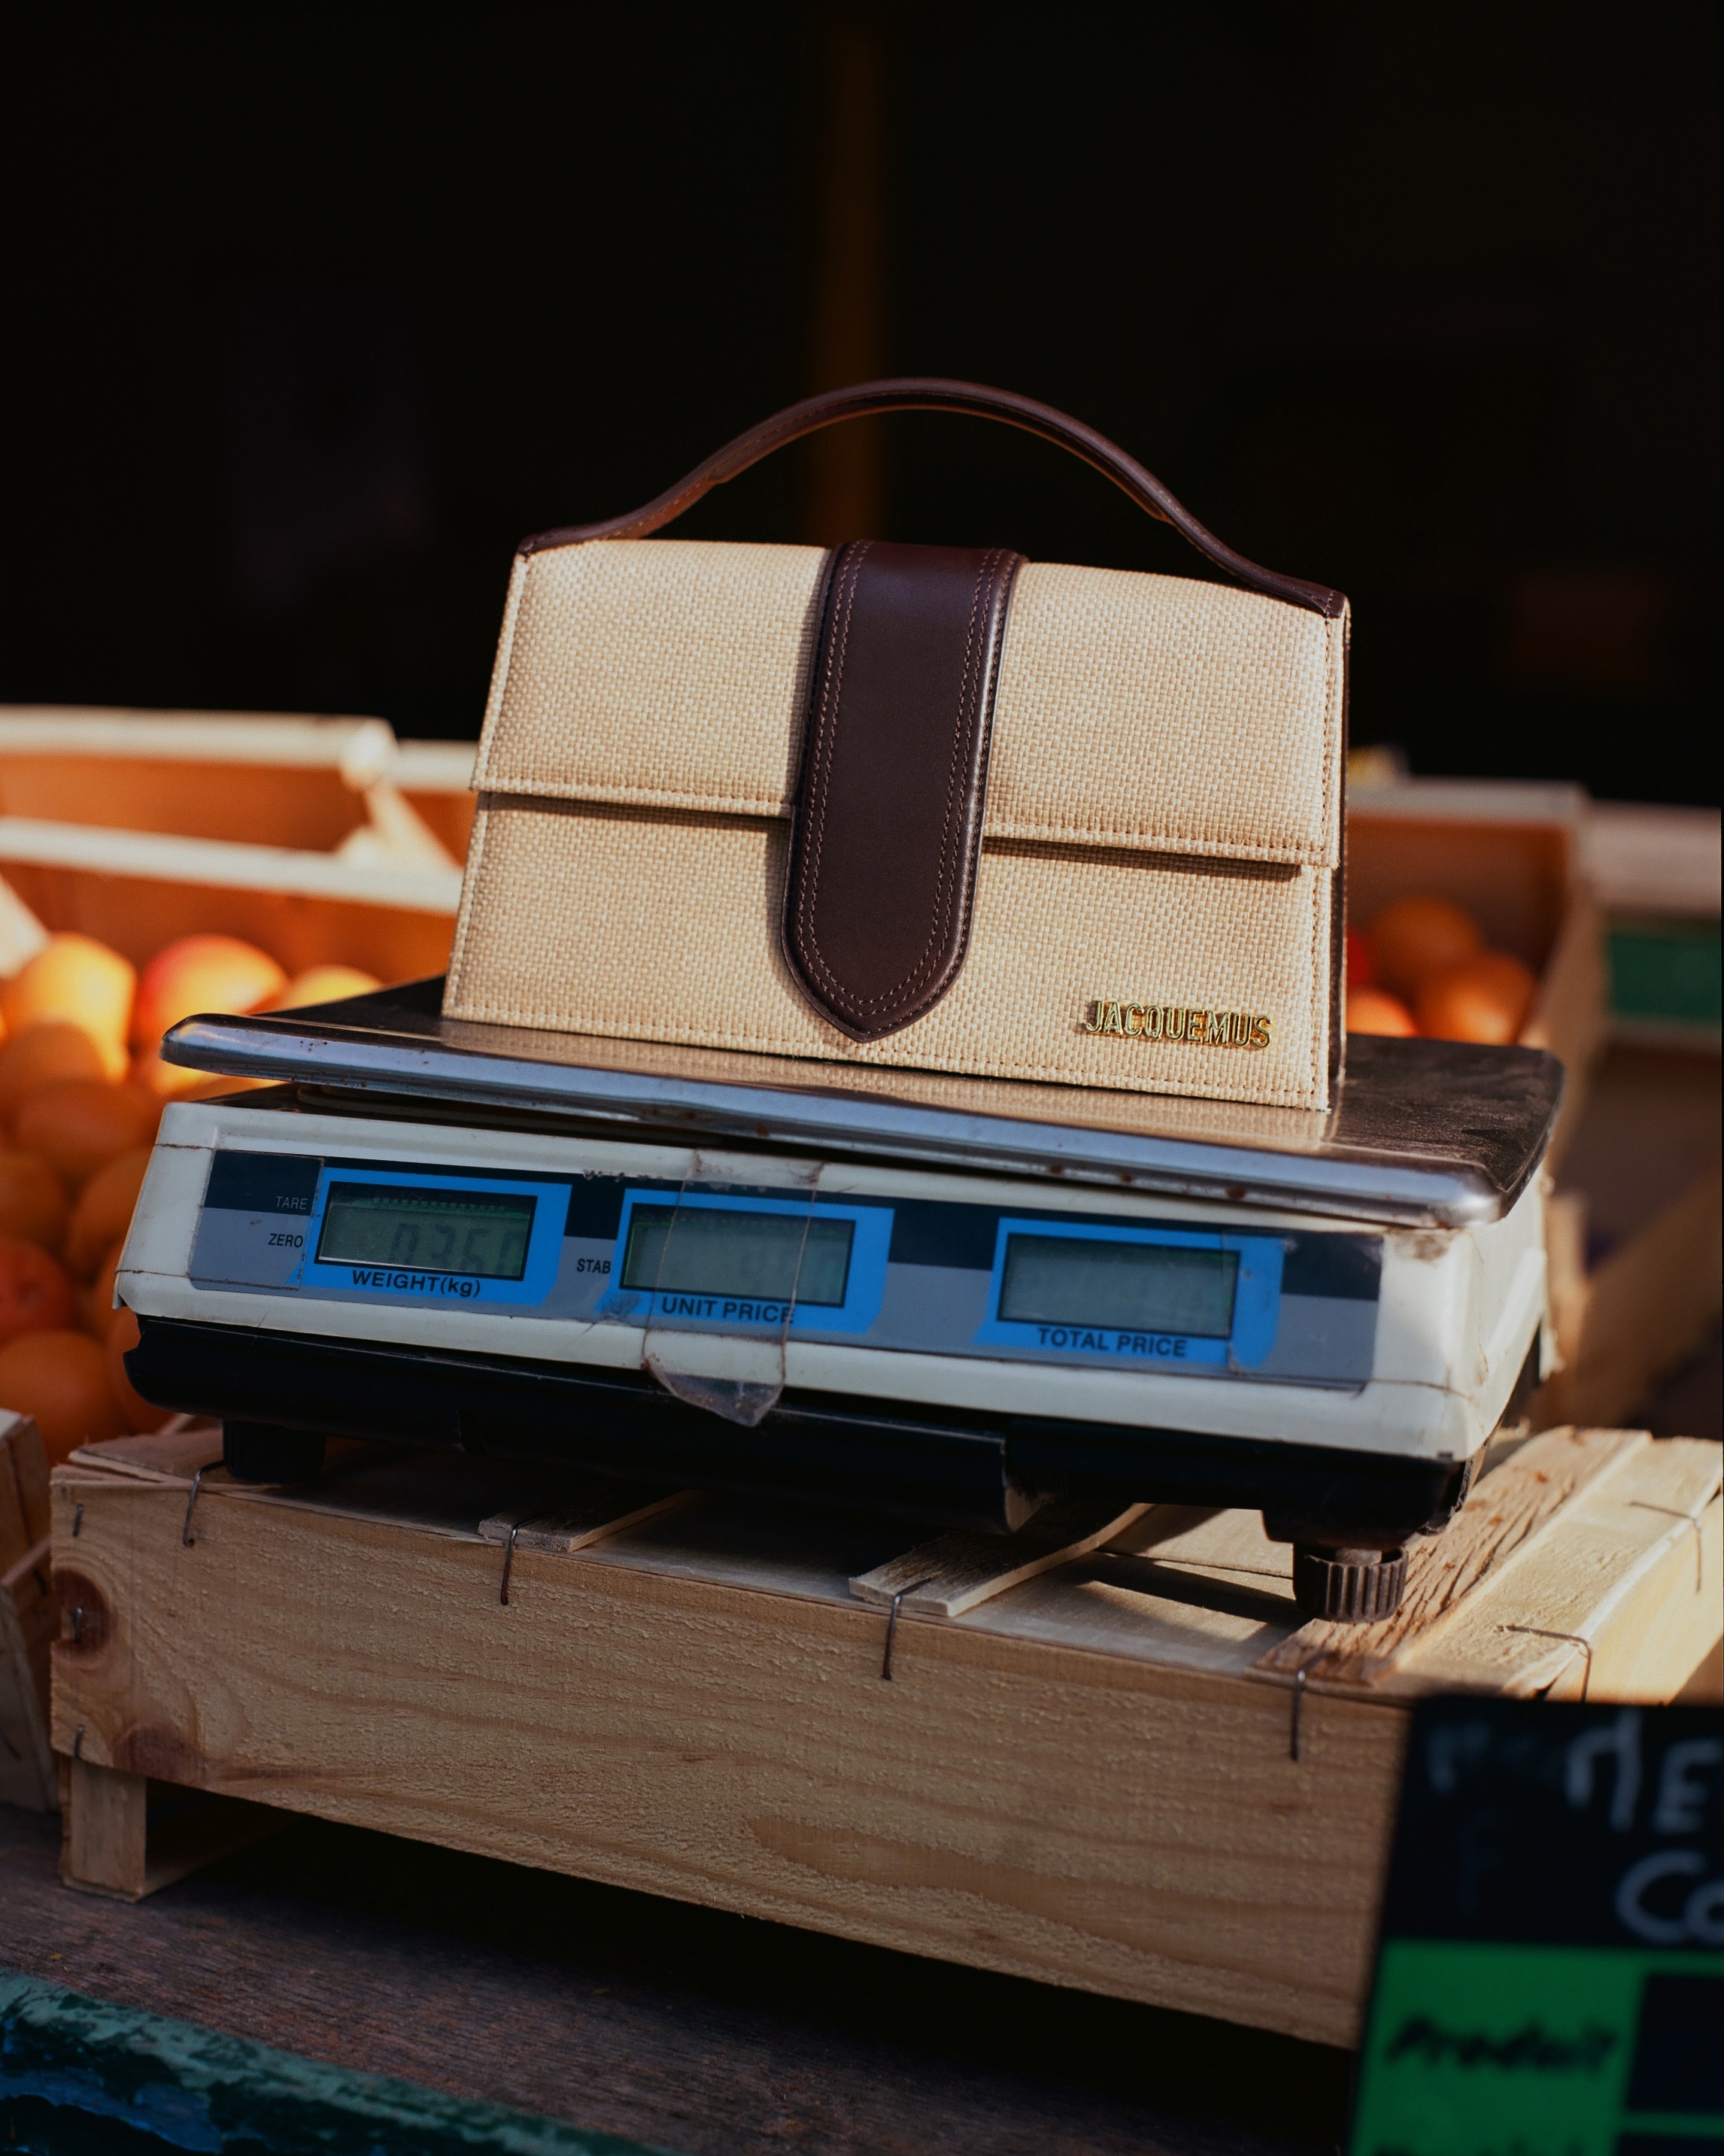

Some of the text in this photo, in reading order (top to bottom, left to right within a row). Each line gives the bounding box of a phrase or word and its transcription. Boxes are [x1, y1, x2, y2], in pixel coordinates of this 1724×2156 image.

[1085, 1000, 1272, 1049] JACQUEMUS
[275, 1196, 308, 1210] TARE
[268, 1233, 304, 1248] ZERO
[576, 1258, 612, 1274] STAB
[351, 1269, 481, 1298] WEIGHT(kg)
[661, 1296, 794, 1325] UNIT PRICE
[1039, 1327, 1188, 1356] TOTAL PRICE
